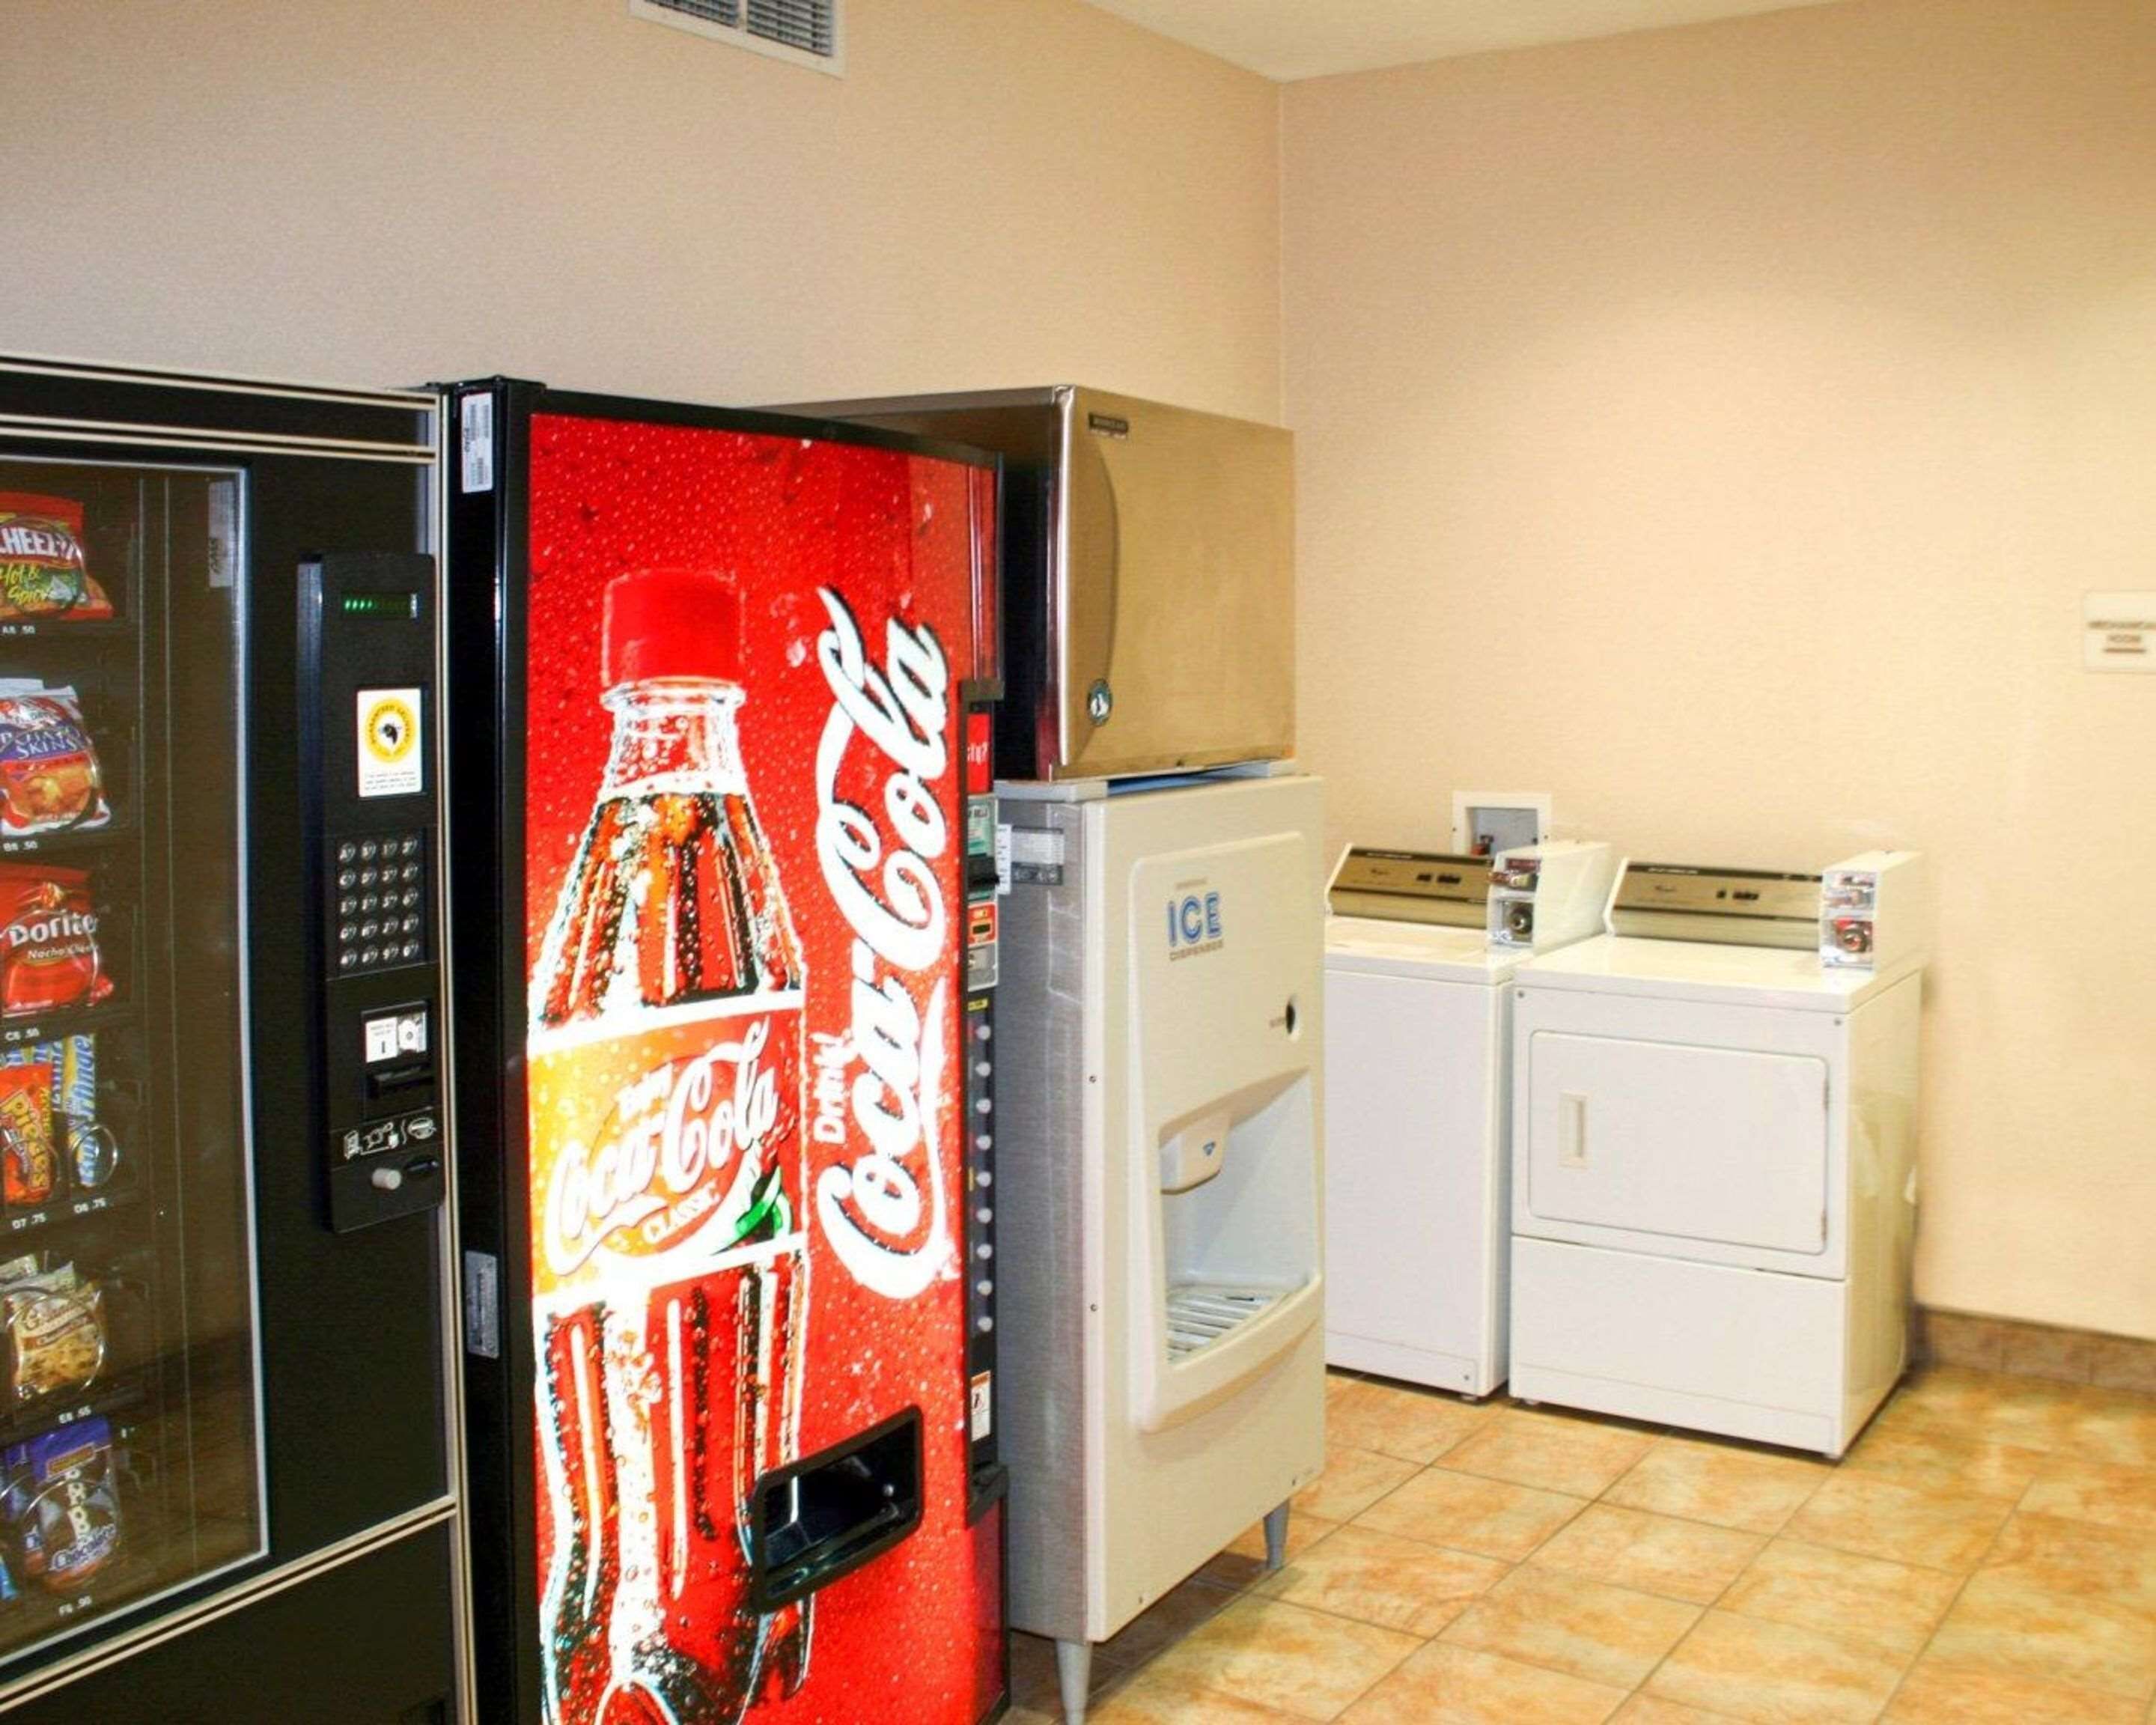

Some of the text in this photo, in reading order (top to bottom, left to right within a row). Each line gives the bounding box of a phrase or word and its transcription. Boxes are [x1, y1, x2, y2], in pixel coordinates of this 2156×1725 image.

[9, 909, 99, 947] Dorito
[814, 584, 960, 1300] Coca-Cola
[1167, 892, 1222, 948] ICE
[544, 1015, 779, 1276] Coca-Cola
